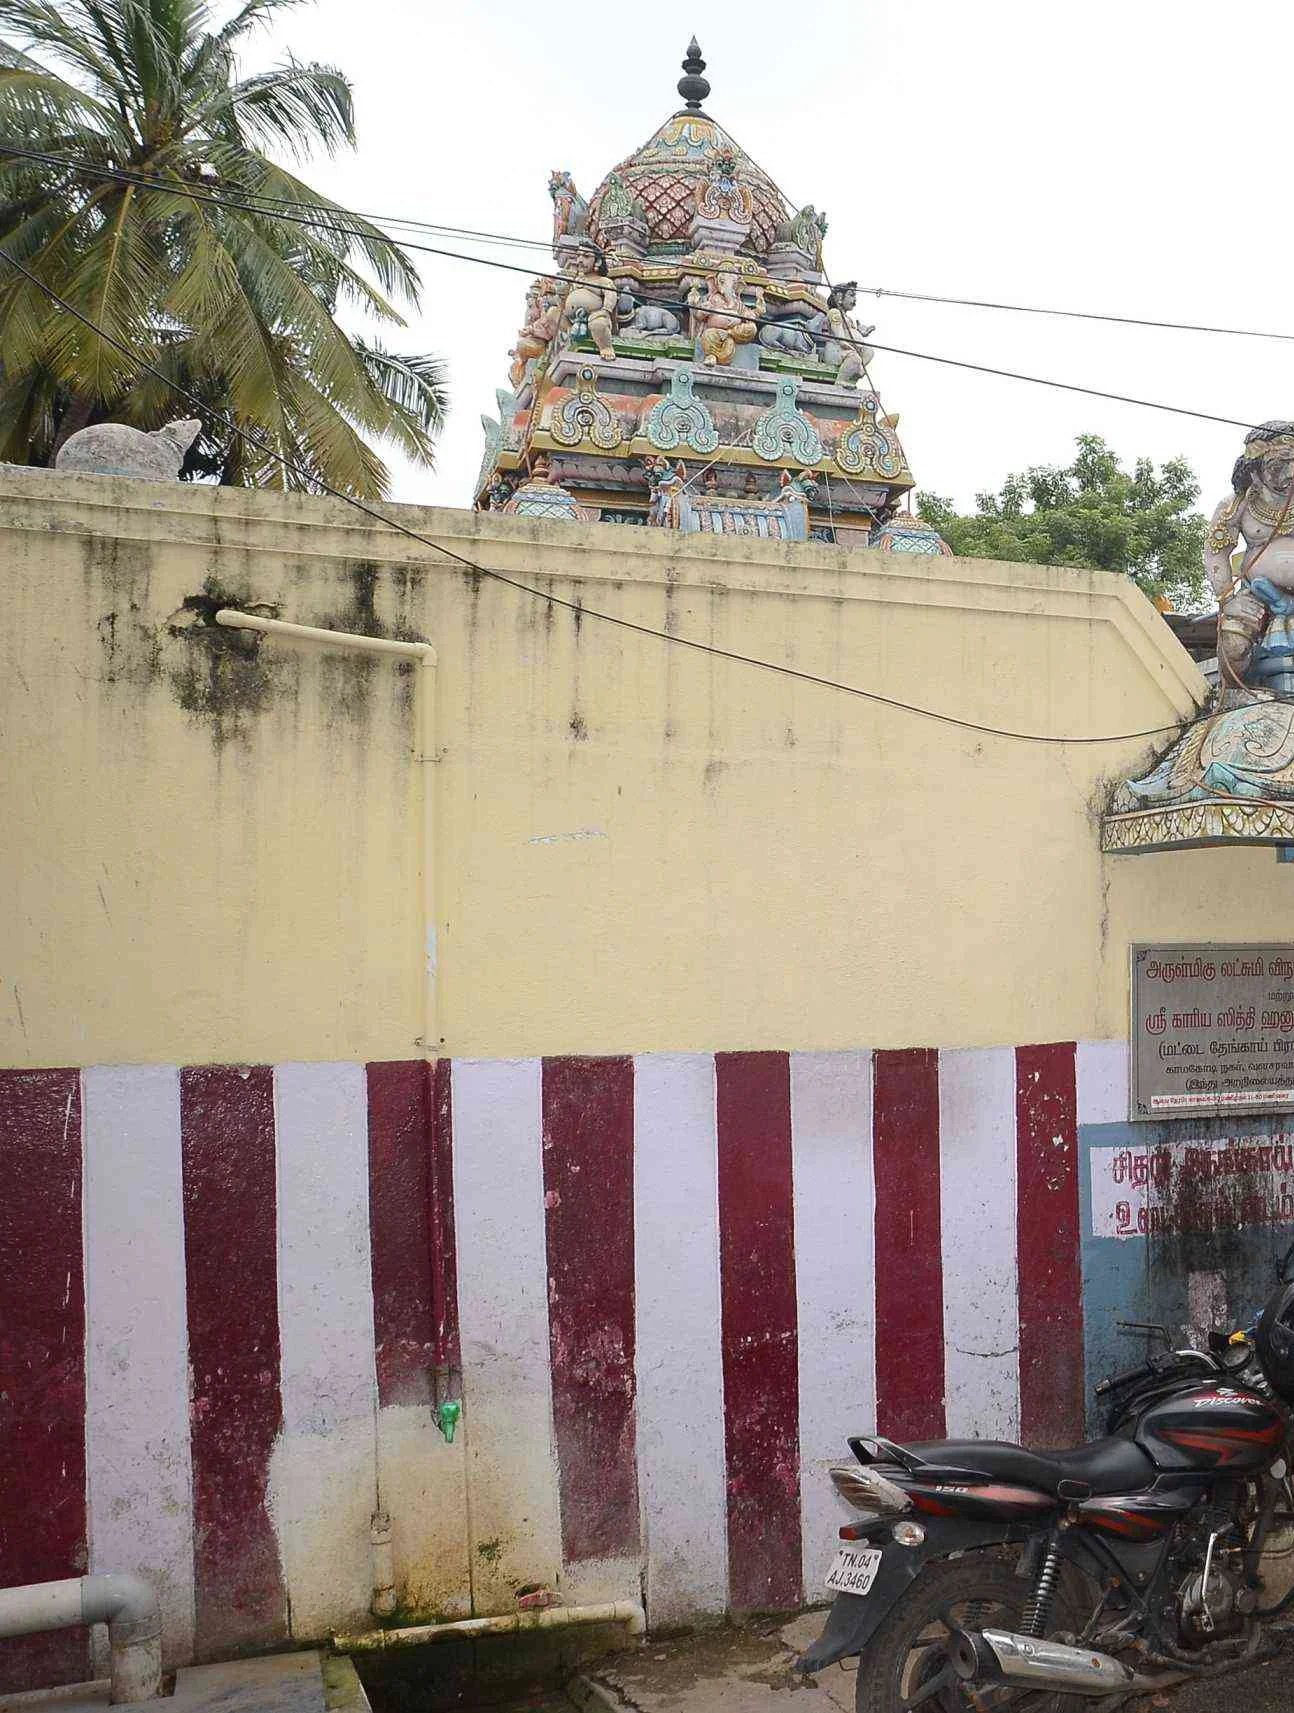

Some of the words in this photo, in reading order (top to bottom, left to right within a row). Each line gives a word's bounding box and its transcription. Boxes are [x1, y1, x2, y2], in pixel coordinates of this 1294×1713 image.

[1146, 955, 1216, 983] அருள்மிகு
[1220, 956, 1264, 977] லட்சுமி
[1172, 1006, 1212, 1029] காரிய
[1216, 1004, 1256, 1033] ஸித்தி
[1159, 1040, 1204, 1060] (மட்டை
[1209, 1037, 1268, 1058] தேங்காய்
